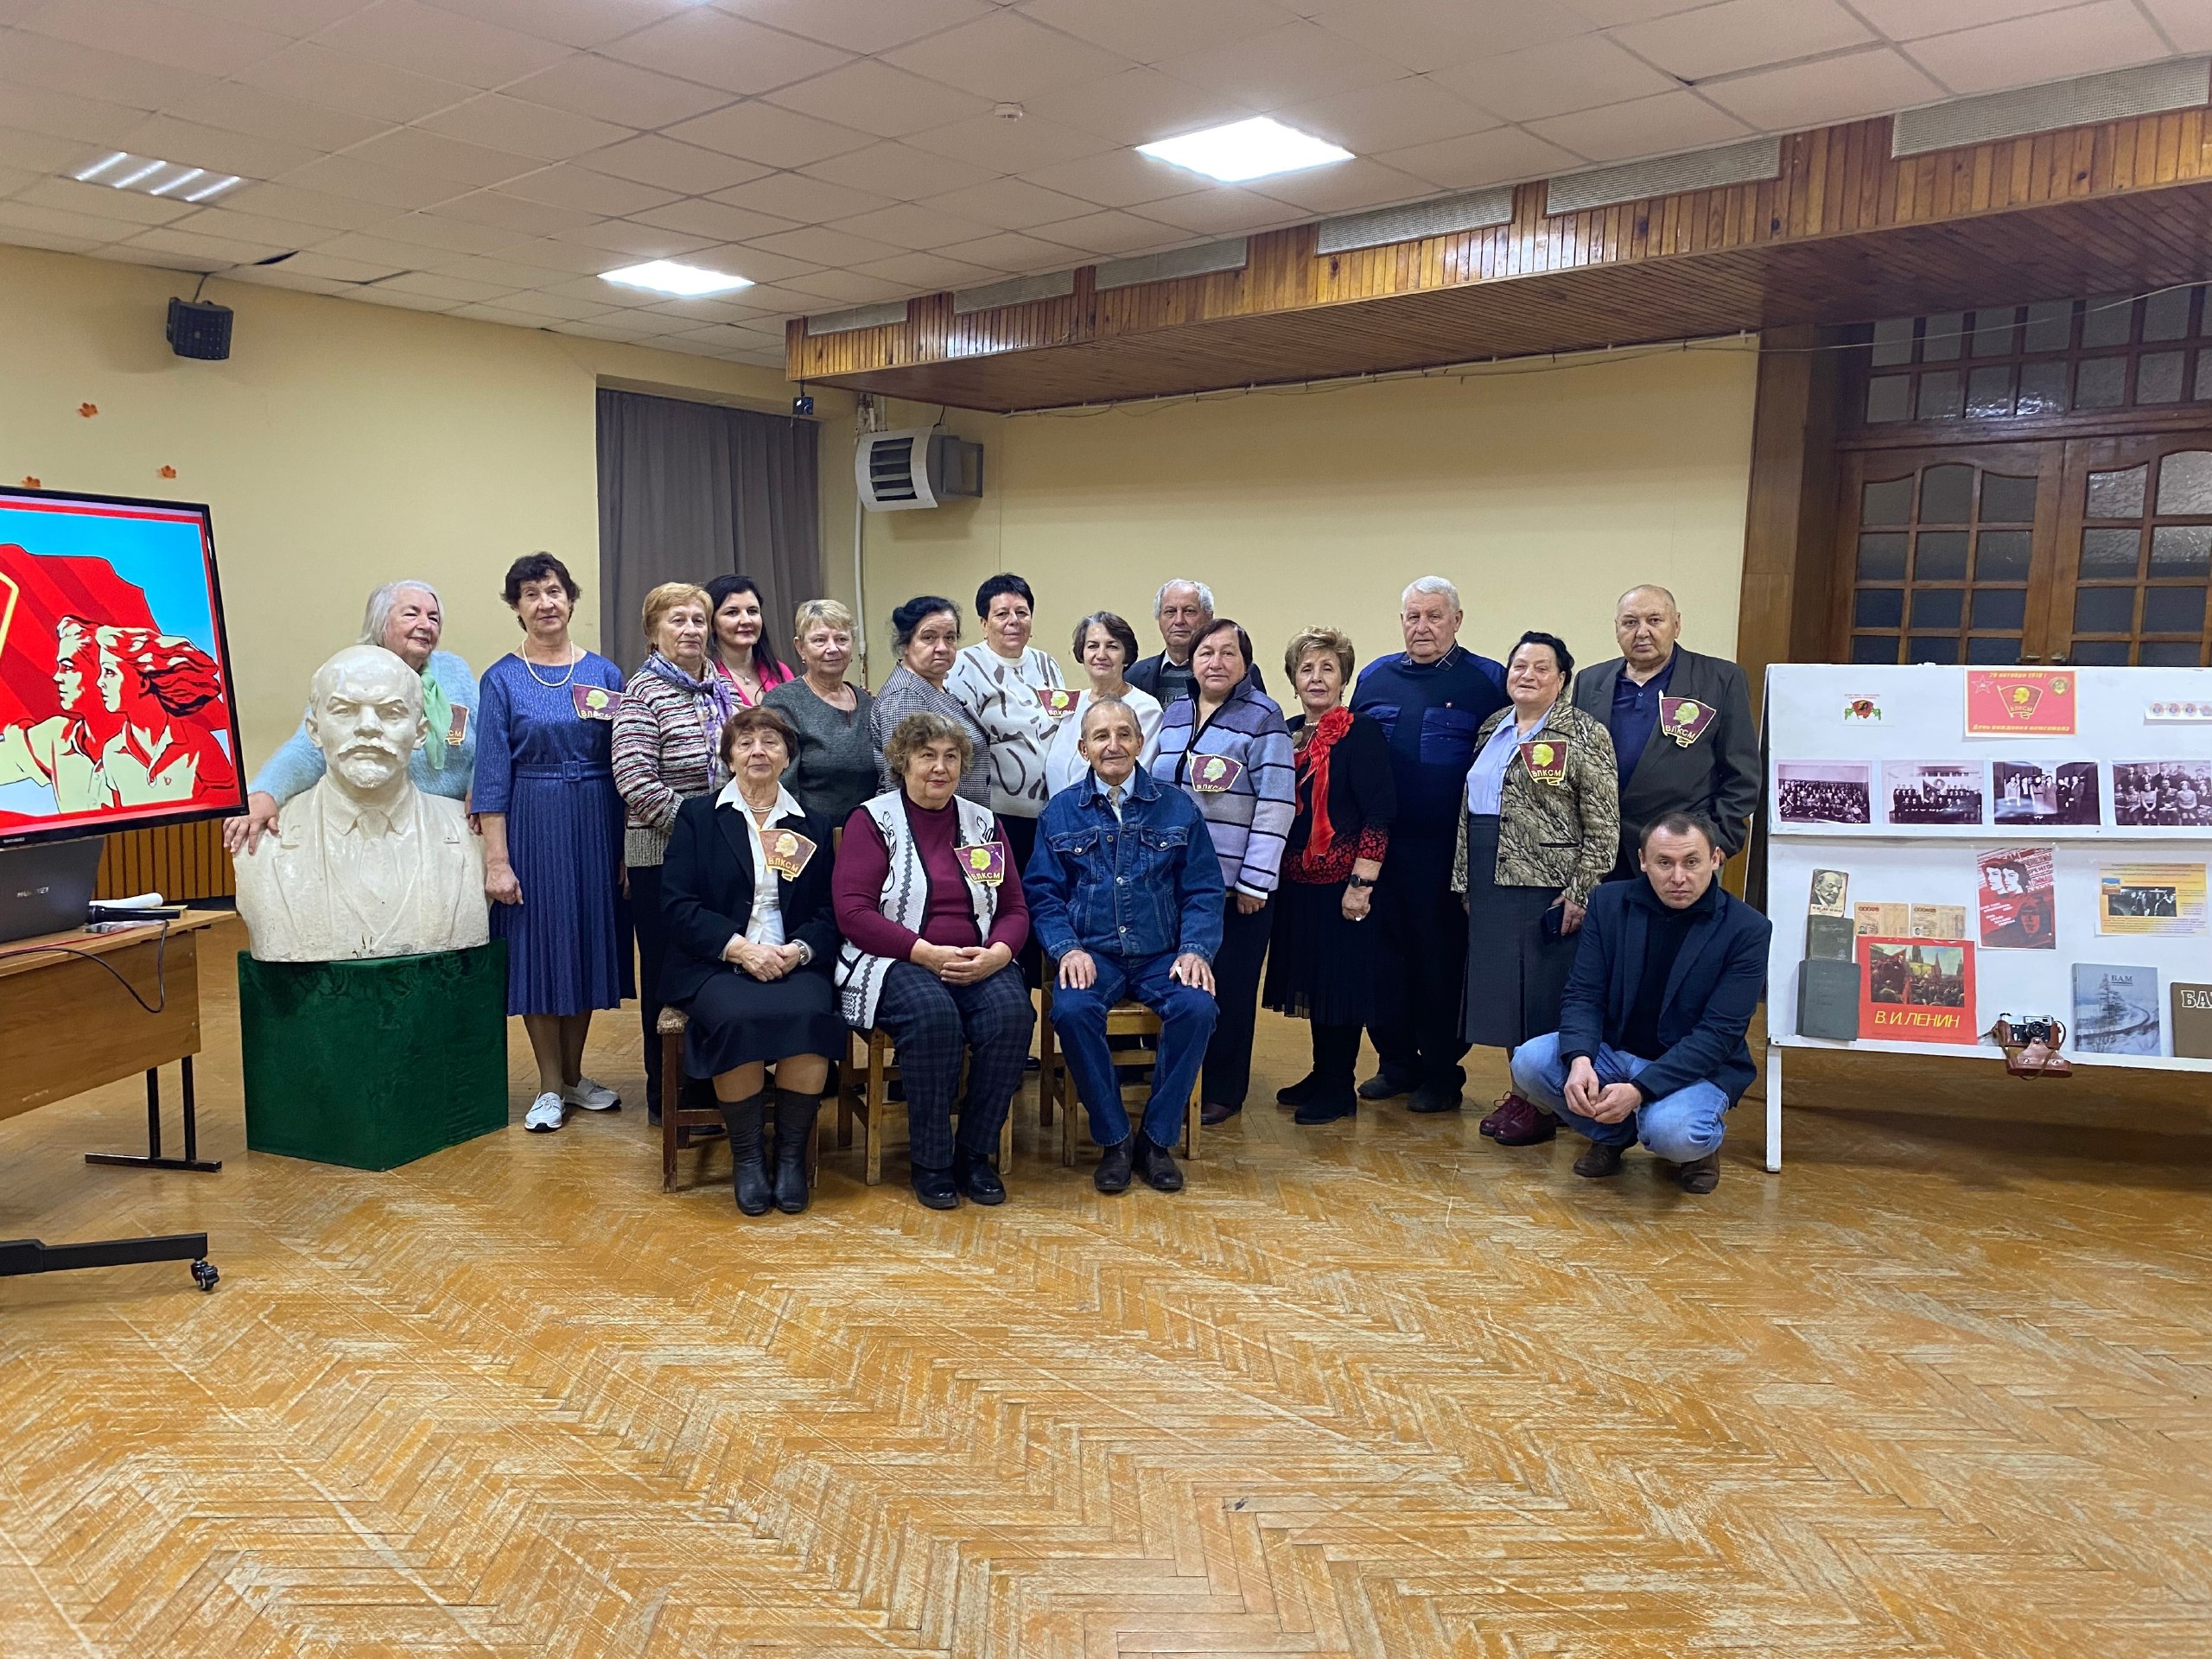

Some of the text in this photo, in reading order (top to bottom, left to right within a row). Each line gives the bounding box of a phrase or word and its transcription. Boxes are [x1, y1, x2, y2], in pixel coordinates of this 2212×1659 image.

[1665, 724, 1696, 740] ВЛКСМ
[1530, 769, 1562, 778] ВЛКСМ
[767, 857, 799, 873] ВЛКСМ
[970, 872, 1001, 880] ВЛКСМ
[17, 887, 49, 898] HUEI
[2180, 989, 2212, 1009] БА
[1874, 1010, 1887, 1025] В.
[1904, 1012, 1961, 1028] ЛЕНИН
